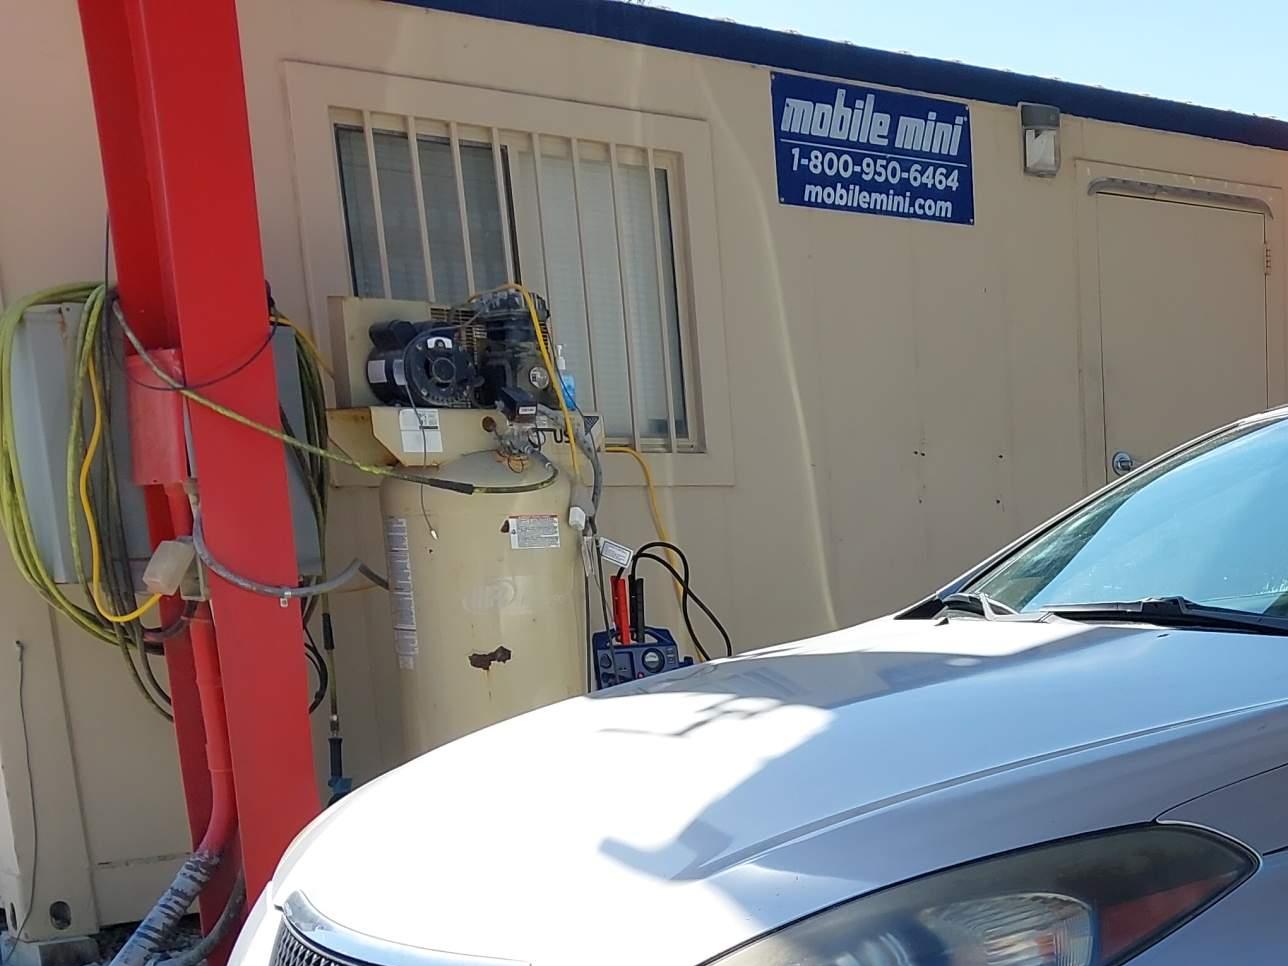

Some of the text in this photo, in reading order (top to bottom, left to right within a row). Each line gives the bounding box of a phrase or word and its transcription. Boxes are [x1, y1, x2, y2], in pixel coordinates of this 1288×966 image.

[781, 88, 963, 156] mobile mini
[791, 147, 959, 191] 1-800-950-6464
[804, 182, 952, 218] mobilemini.com
